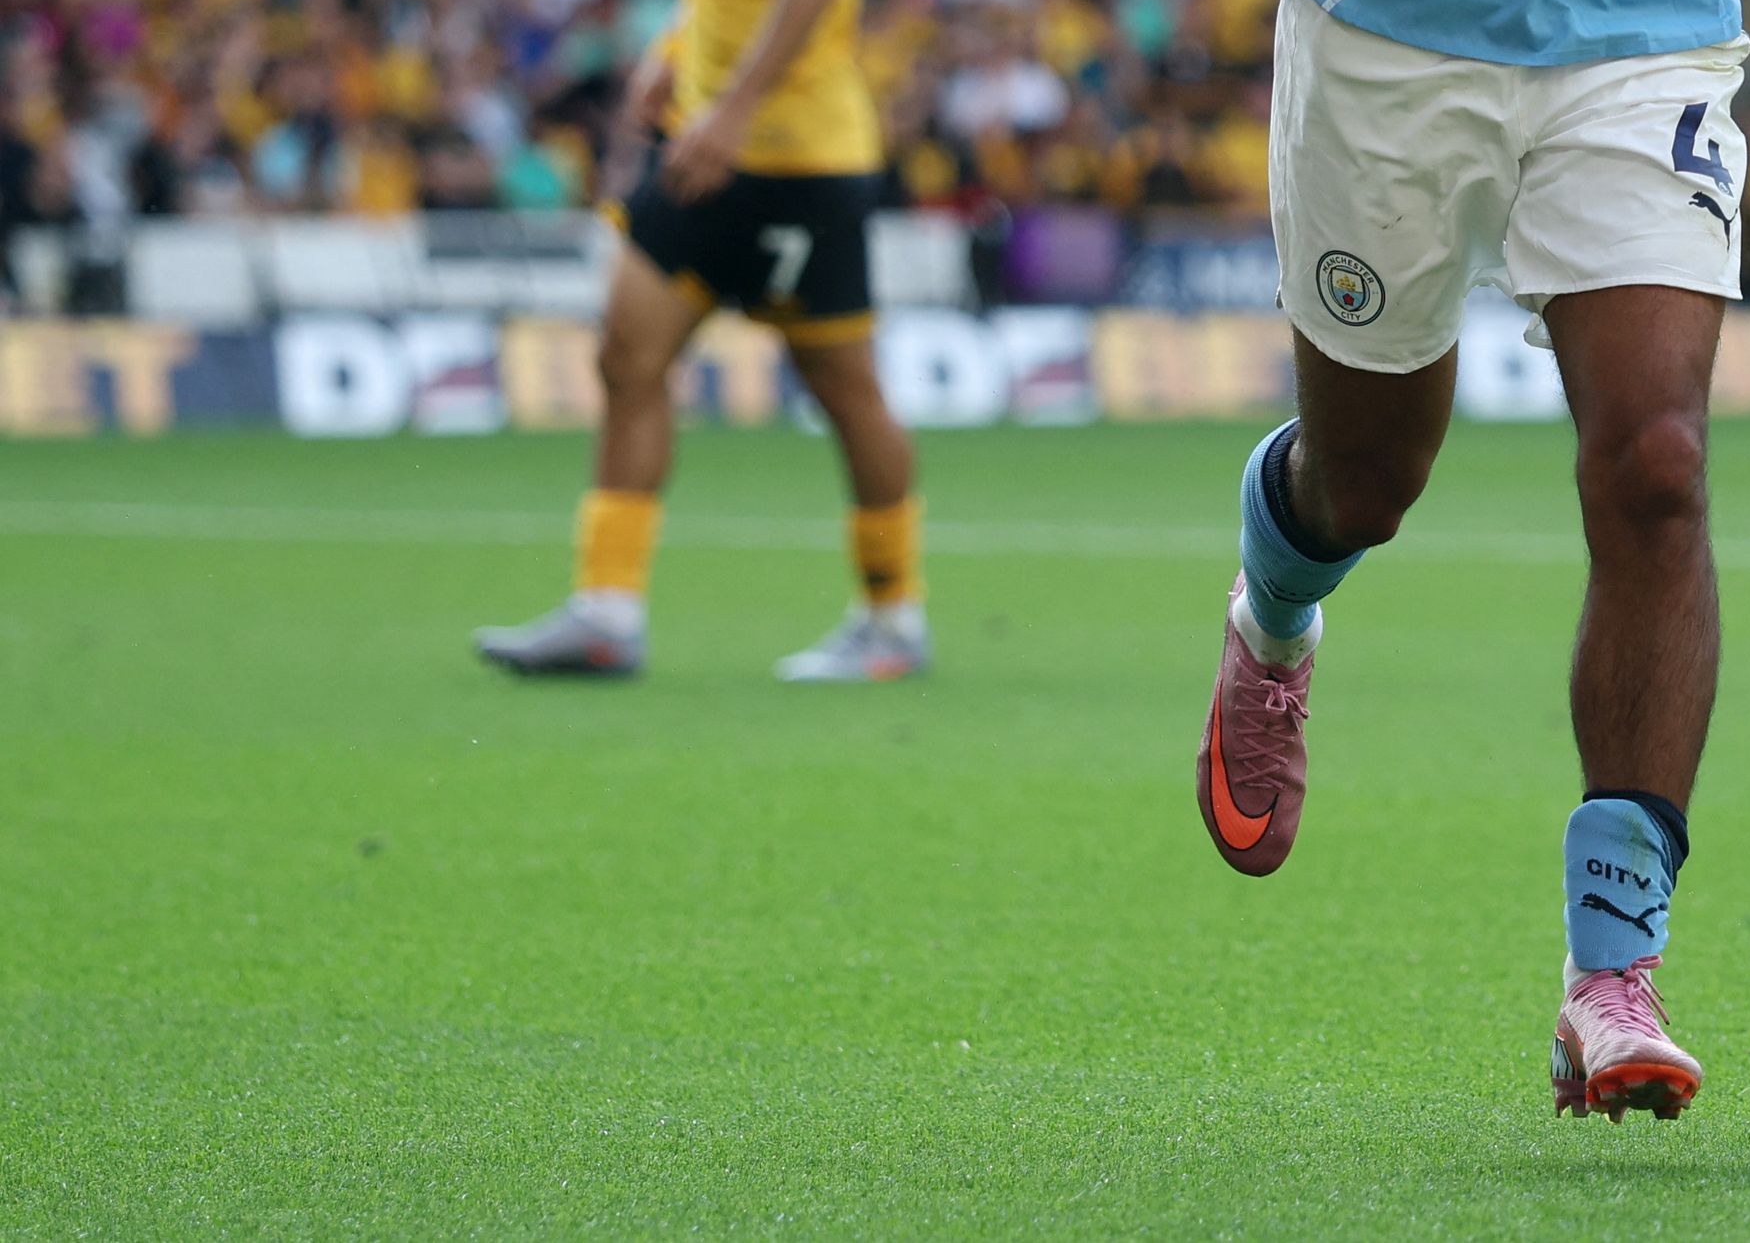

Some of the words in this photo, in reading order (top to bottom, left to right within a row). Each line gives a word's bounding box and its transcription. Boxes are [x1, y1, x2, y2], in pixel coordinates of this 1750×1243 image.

[1671, 101, 1735, 198] 4
[757, 223, 812, 295] 7
[1322, 256, 1374, 284] MANCHESTER
[1340, 311, 1361, 321] CITY
[1586, 858, 1652, 890] CITY
